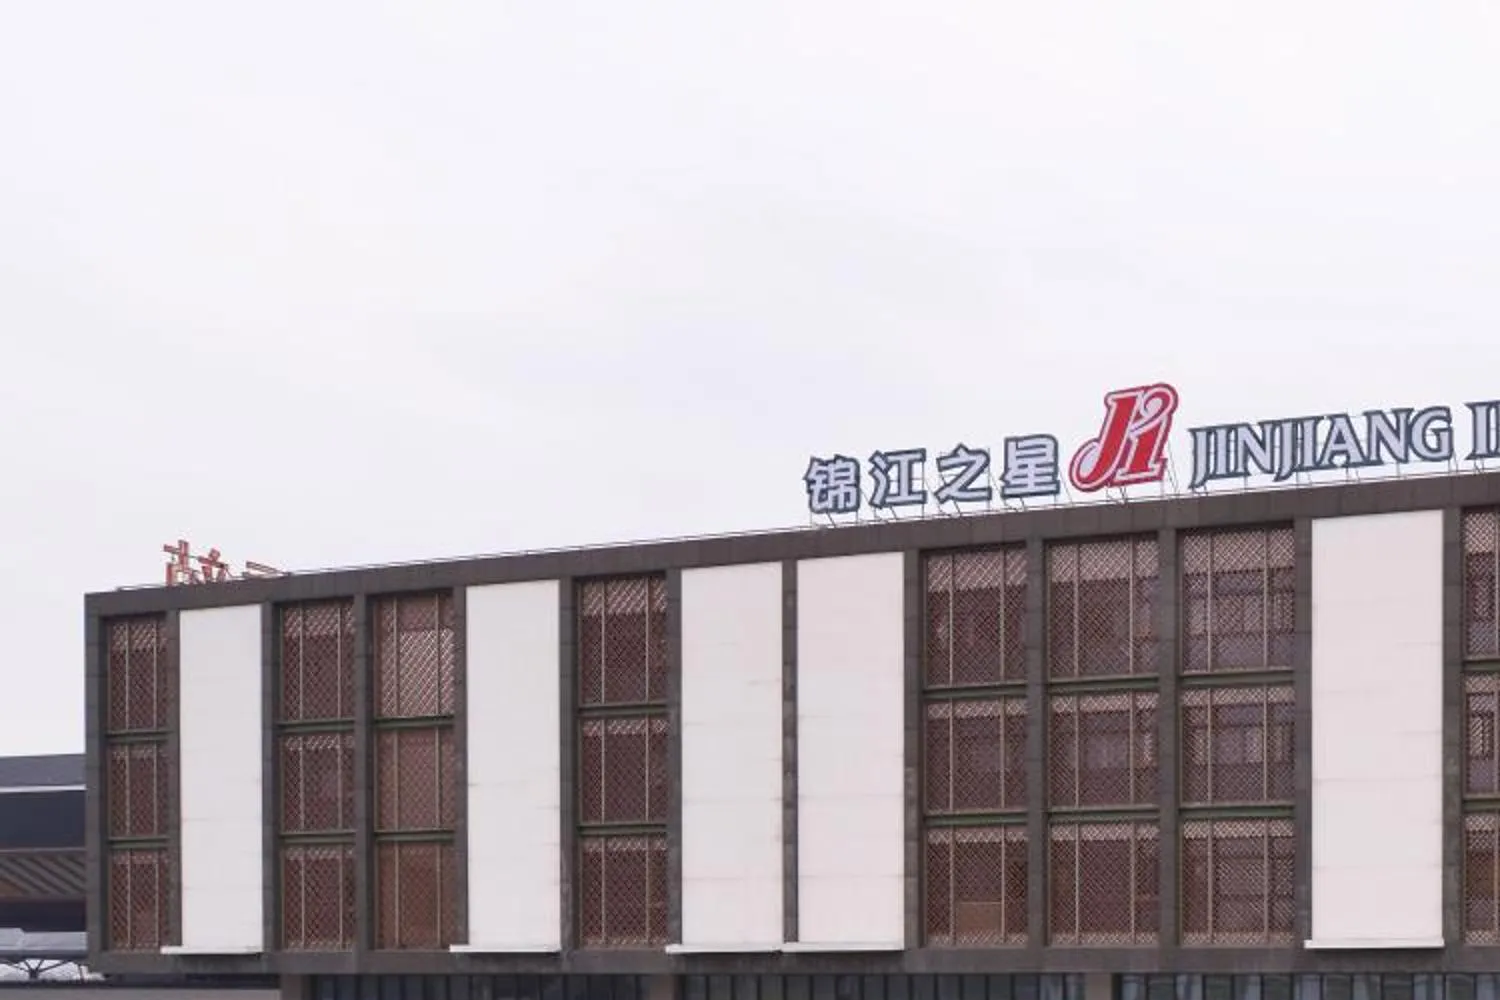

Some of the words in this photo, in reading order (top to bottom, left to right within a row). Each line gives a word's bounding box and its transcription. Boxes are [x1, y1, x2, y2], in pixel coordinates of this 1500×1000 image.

[803, 434, 1061, 514] 锦江之星
[1187, 406, 1454, 488] JINJIANG
